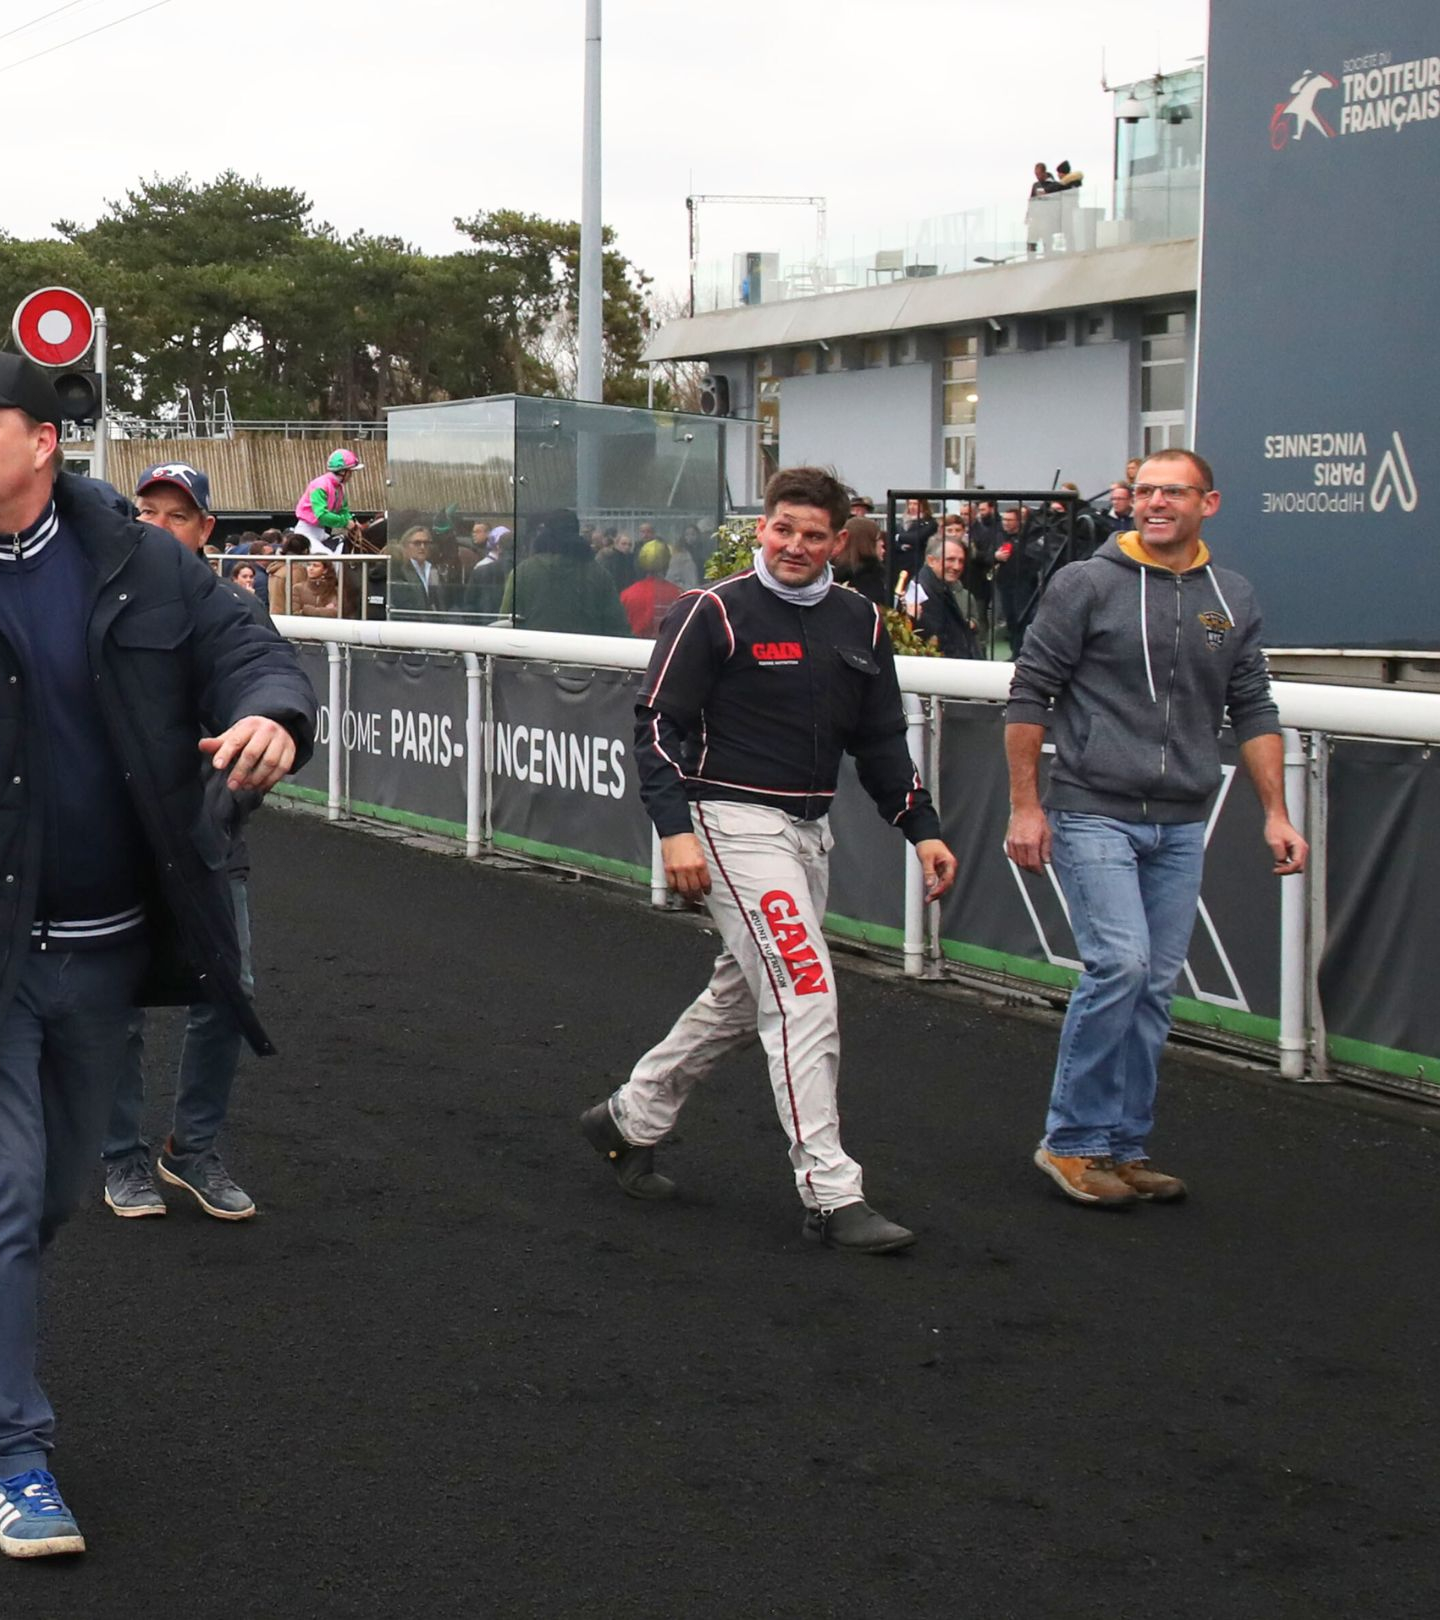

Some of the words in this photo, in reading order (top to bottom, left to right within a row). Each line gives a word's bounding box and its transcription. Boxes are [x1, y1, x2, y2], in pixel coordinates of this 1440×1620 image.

[1342, 56, 1440, 104] TROTTEUR
[1340, 88, 1440, 135] FRANÇAIS
[1264, 432, 1367, 459] VINCENNES
[1314, 462, 1366, 487] PARIS
[1261, 492, 1365, 513] HIPPODROME
[752, 641, 803, 660] GAIN
[391, 708, 626, 800] PARIS-INCENNES
[748, 909, 768, 942] EQUINE
[763, 942, 788, 989] NUTRITION
[759, 889, 829, 996] GAIN
